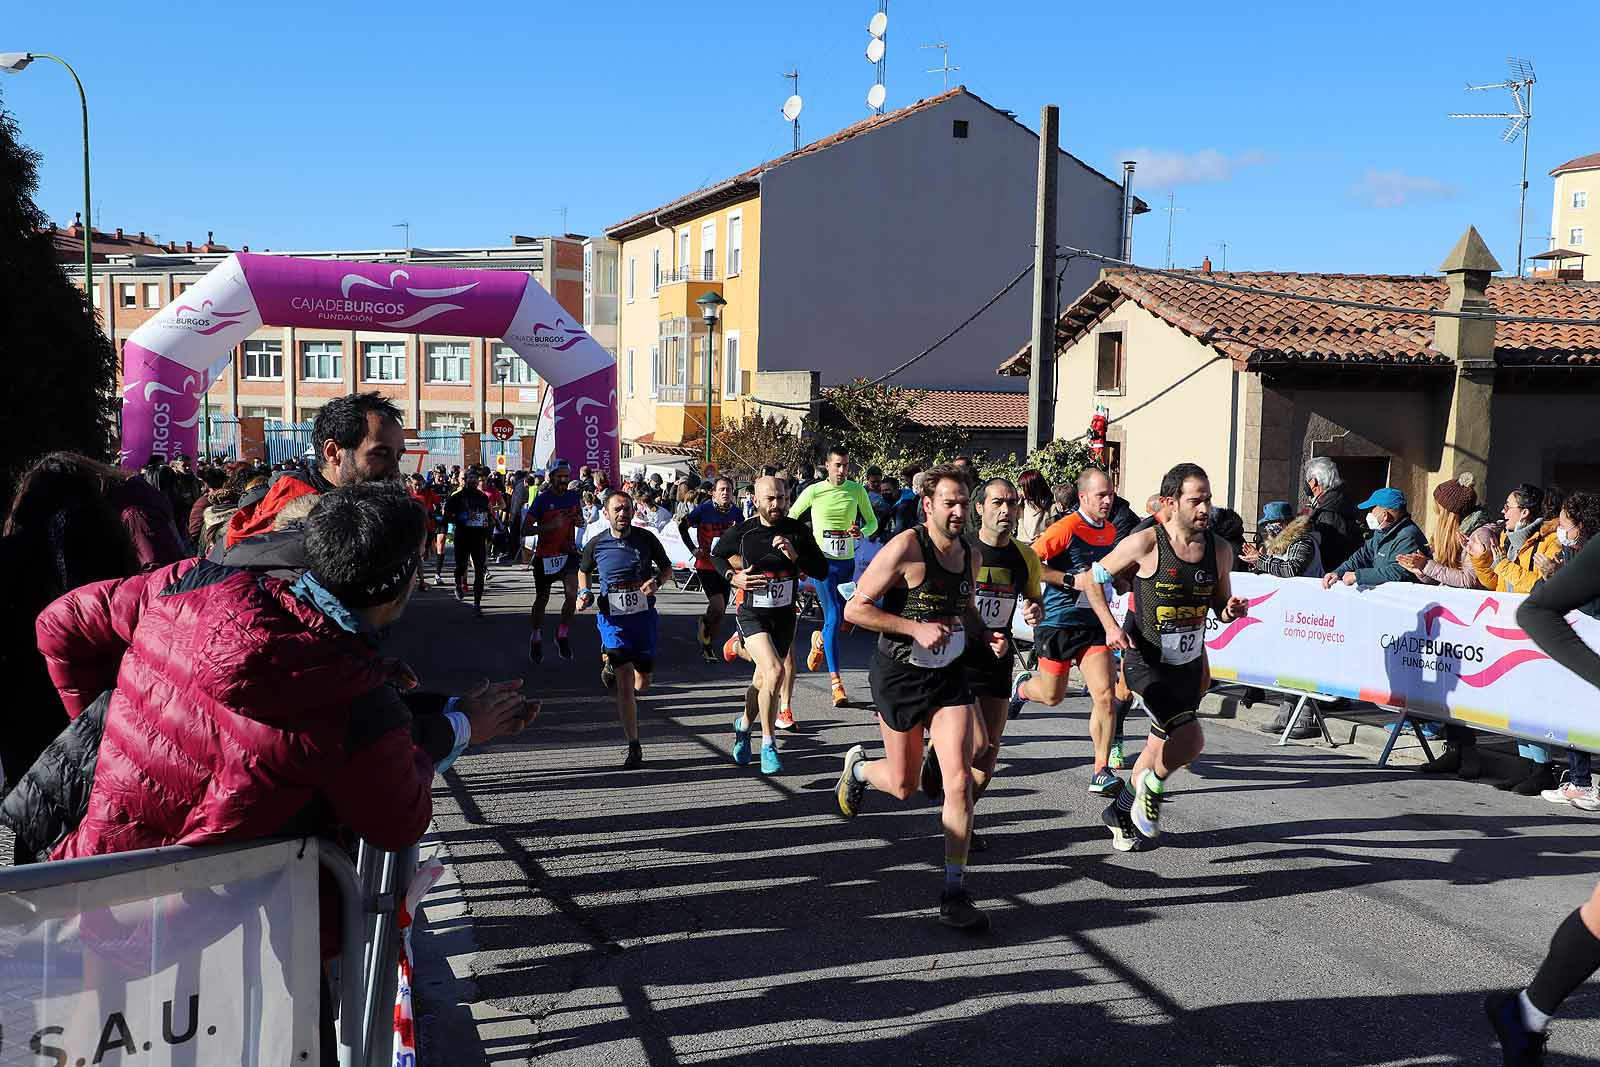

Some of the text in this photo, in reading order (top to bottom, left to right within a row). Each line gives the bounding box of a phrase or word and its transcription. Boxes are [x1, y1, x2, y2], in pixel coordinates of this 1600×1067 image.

[291, 297, 405, 315] CAJADEBURGOS
[318, 312, 373, 322] FUNDACIÓN
[830, 539, 846, 551] 112
[619, 592, 638, 607] 189
[765, 583, 784, 599] 162
[977, 598, 1001, 617] 113
[1284, 611, 1336, 628] La Sociedad
[1179, 633, 1196, 654] 62
[1283, 626, 1345, 644] como proyecto
[1380, 633, 1484, 663] CAJADEBURGOS
[1402, 656, 1452, 673] FUNDACIÓN
